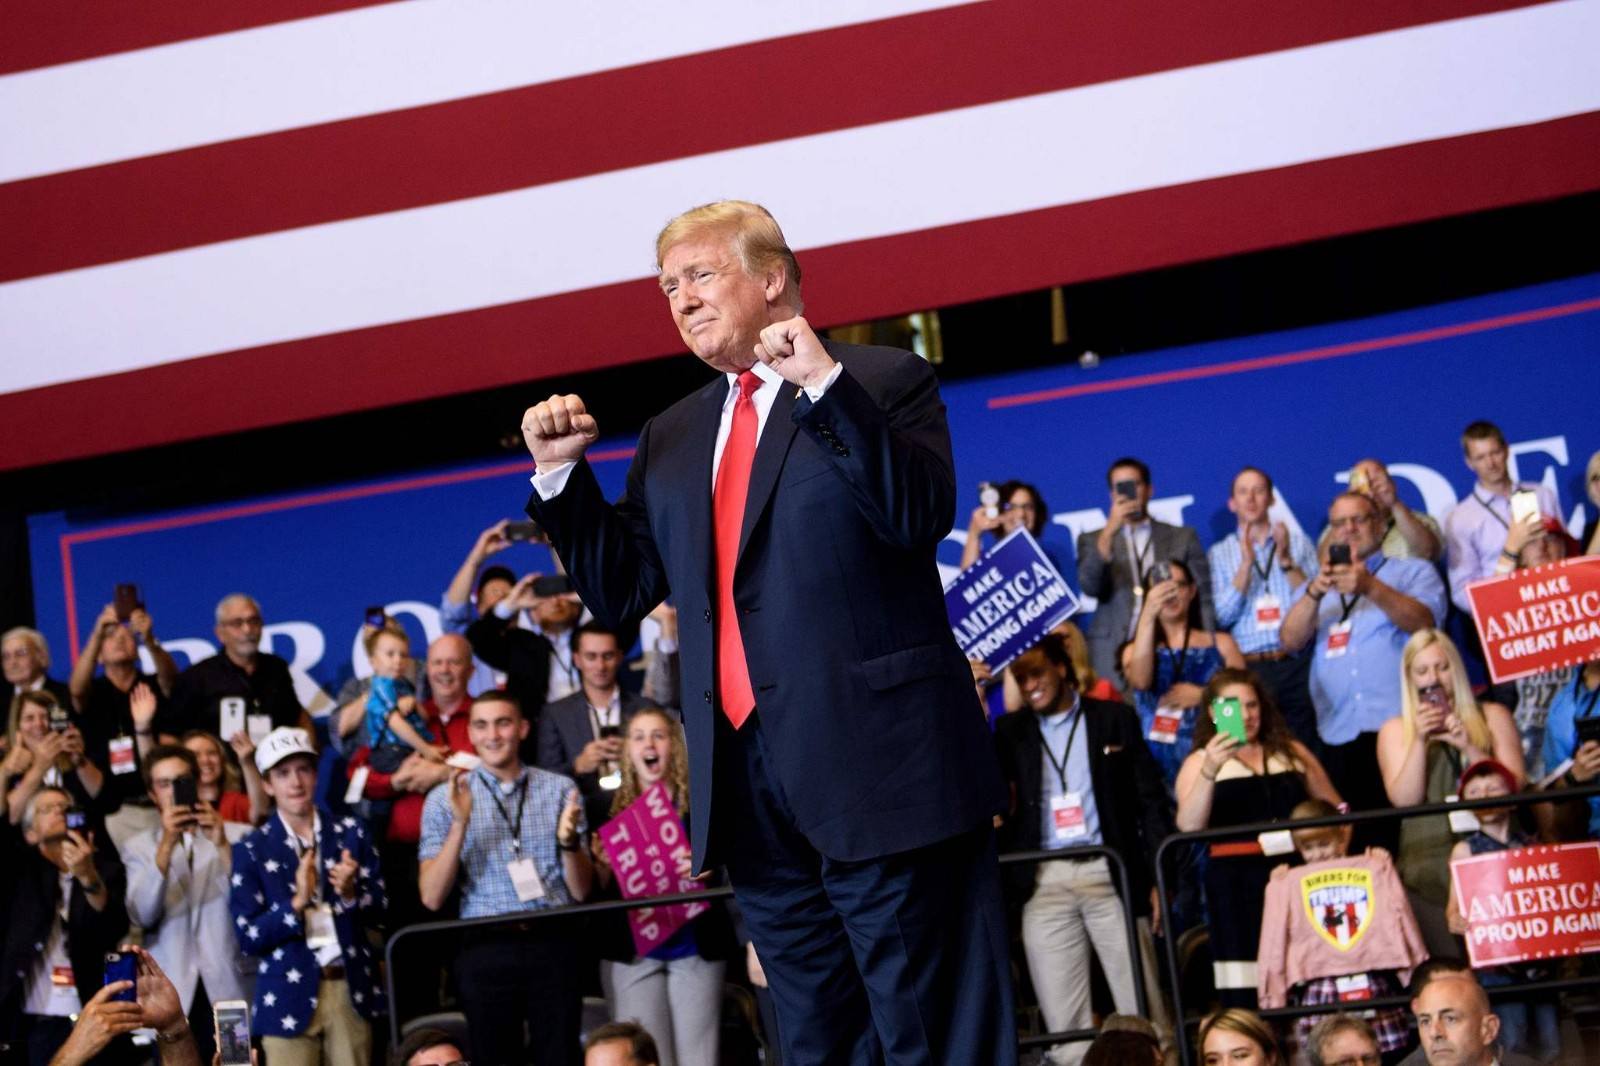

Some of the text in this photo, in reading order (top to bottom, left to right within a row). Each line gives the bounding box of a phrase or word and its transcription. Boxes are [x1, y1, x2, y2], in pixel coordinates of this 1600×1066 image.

[962, 566, 1003, 604] MAKE
[1519, 575, 1571, 602] MAKE
[952, 561, 1053, 649] AMERICA
[1017, 581, 1066, 627] AGAIN
[1500, 631, 1558, 660] GREAT
[645, 843, 670, 894] FOR
[1508, 862, 1561, 885] MAKE
[1473, 917, 1548, 945] PROUD
